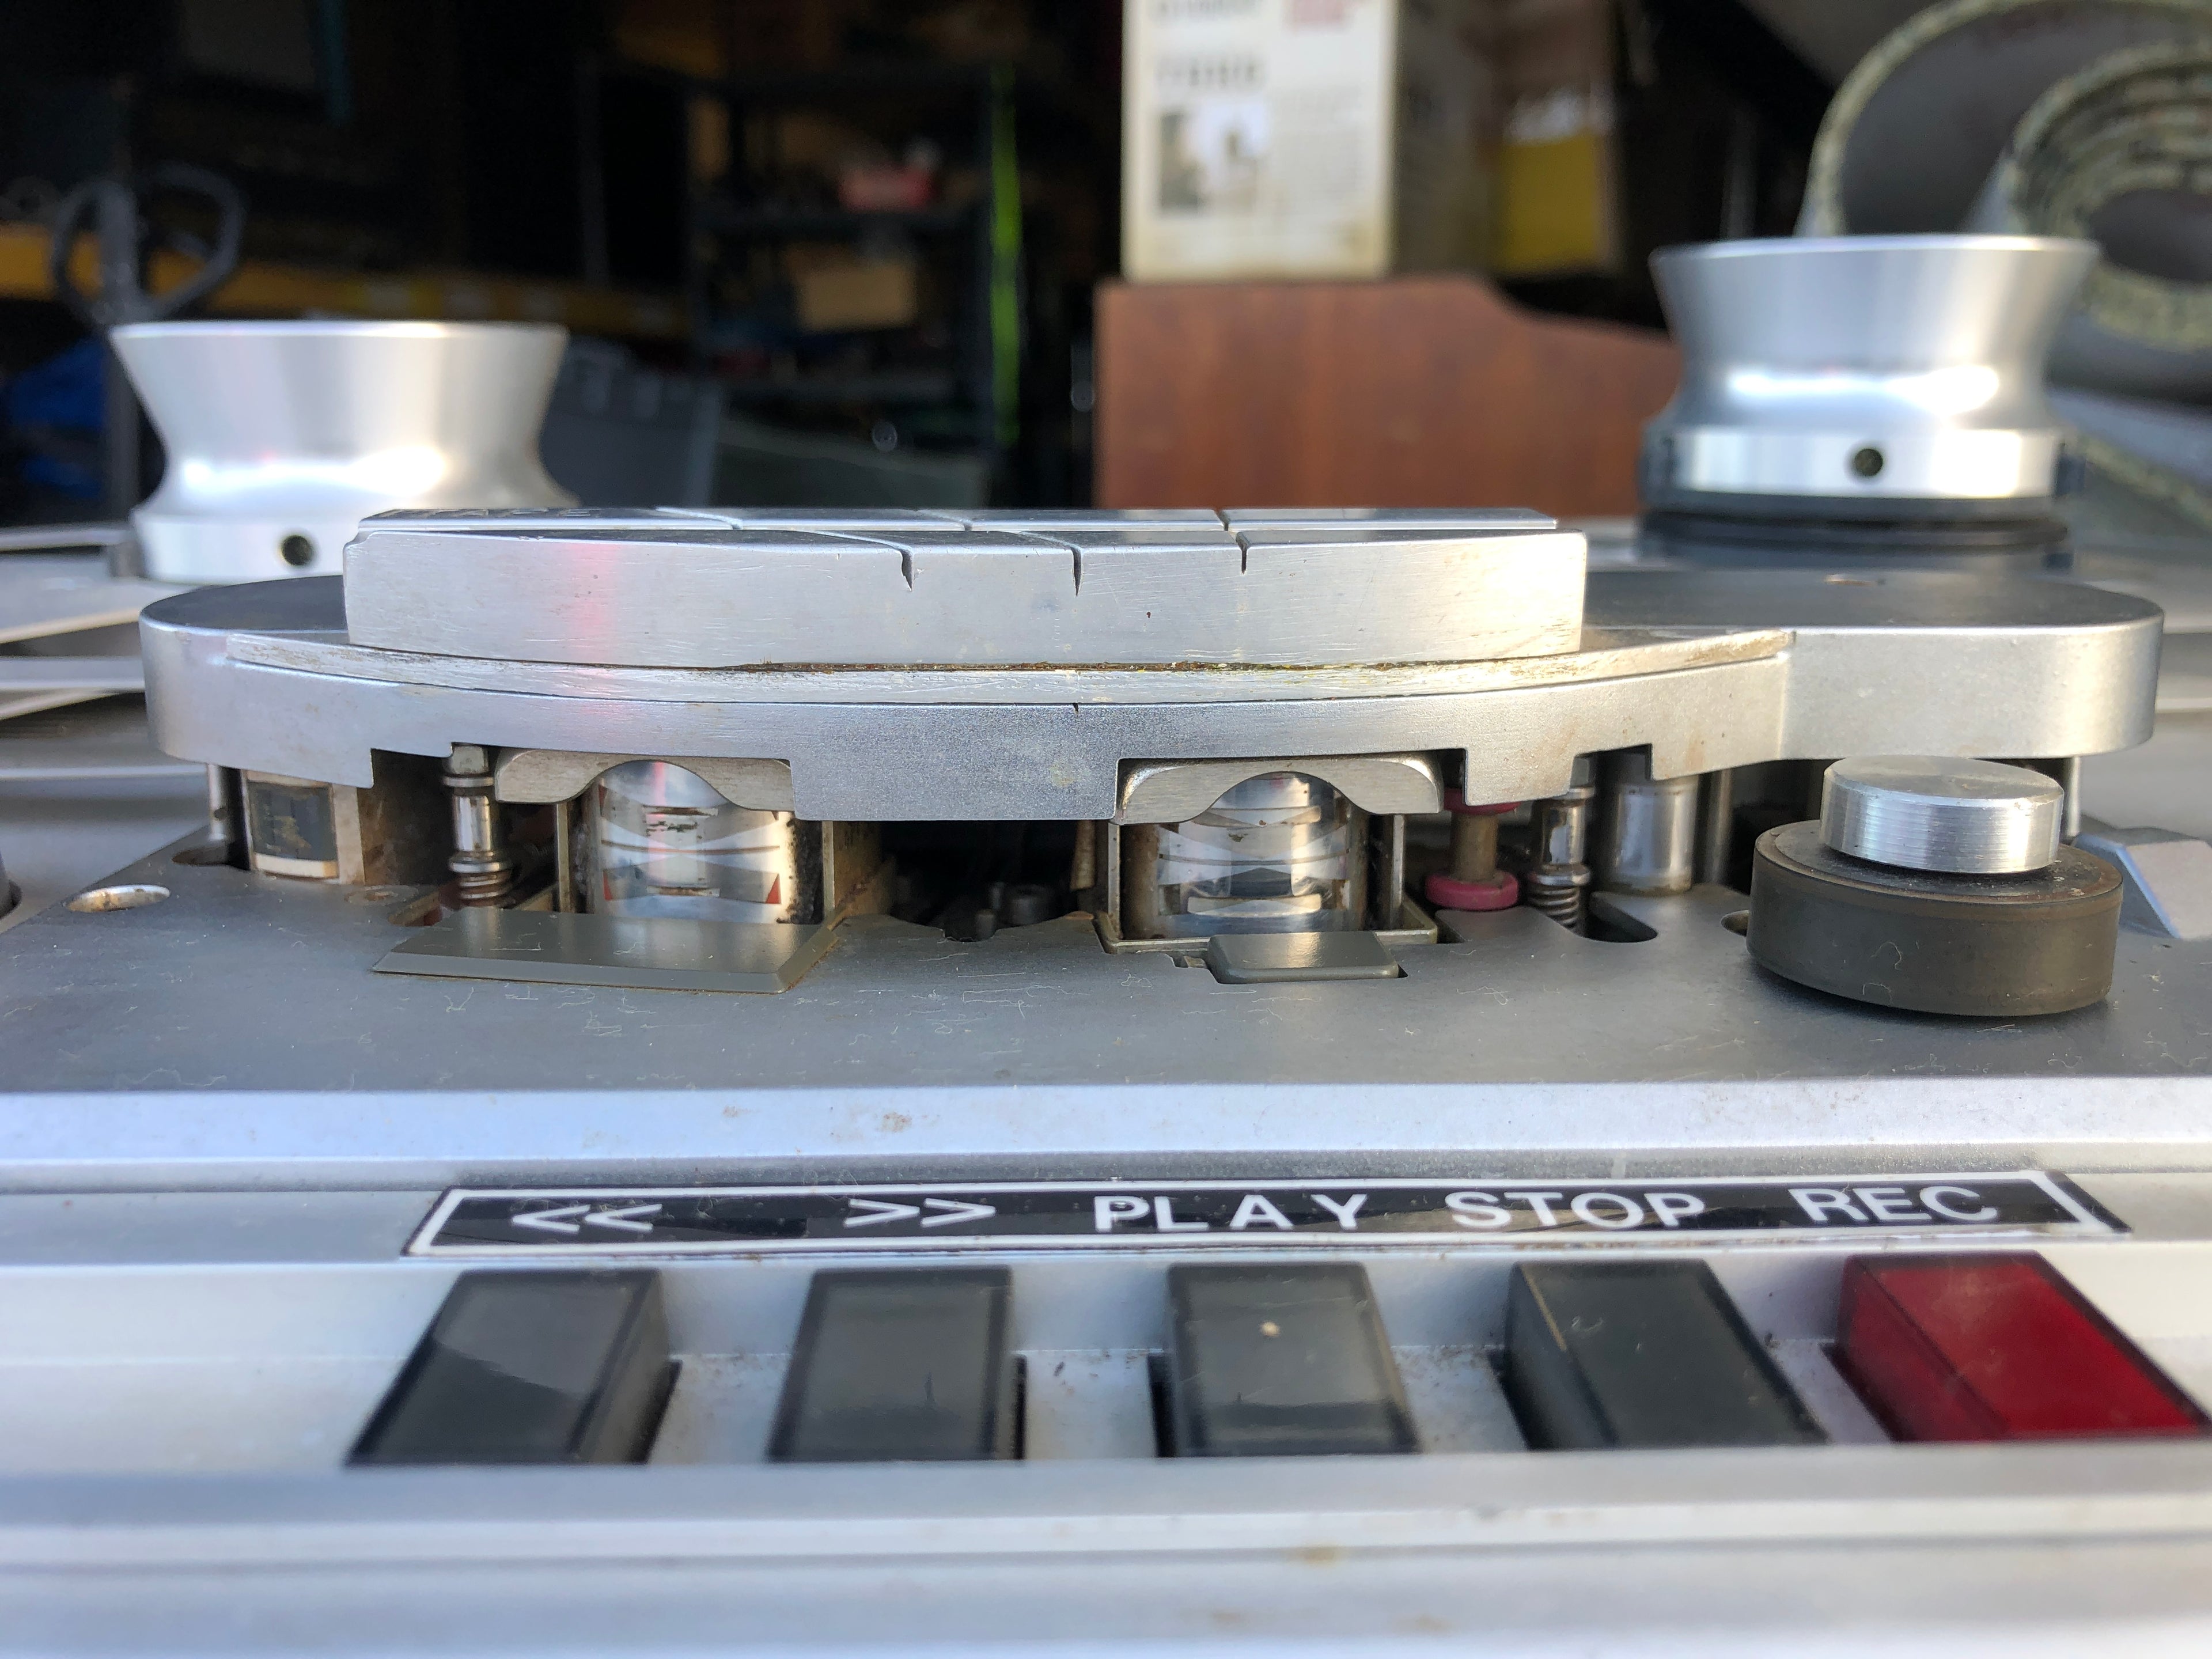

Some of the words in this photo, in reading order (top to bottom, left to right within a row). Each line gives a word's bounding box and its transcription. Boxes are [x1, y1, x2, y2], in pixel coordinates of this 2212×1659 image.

[1093, 1194, 1368, 1233] PLAY
[1444, 1191, 1706, 1230] STOP
[1787, 1185, 1998, 1222] REC
